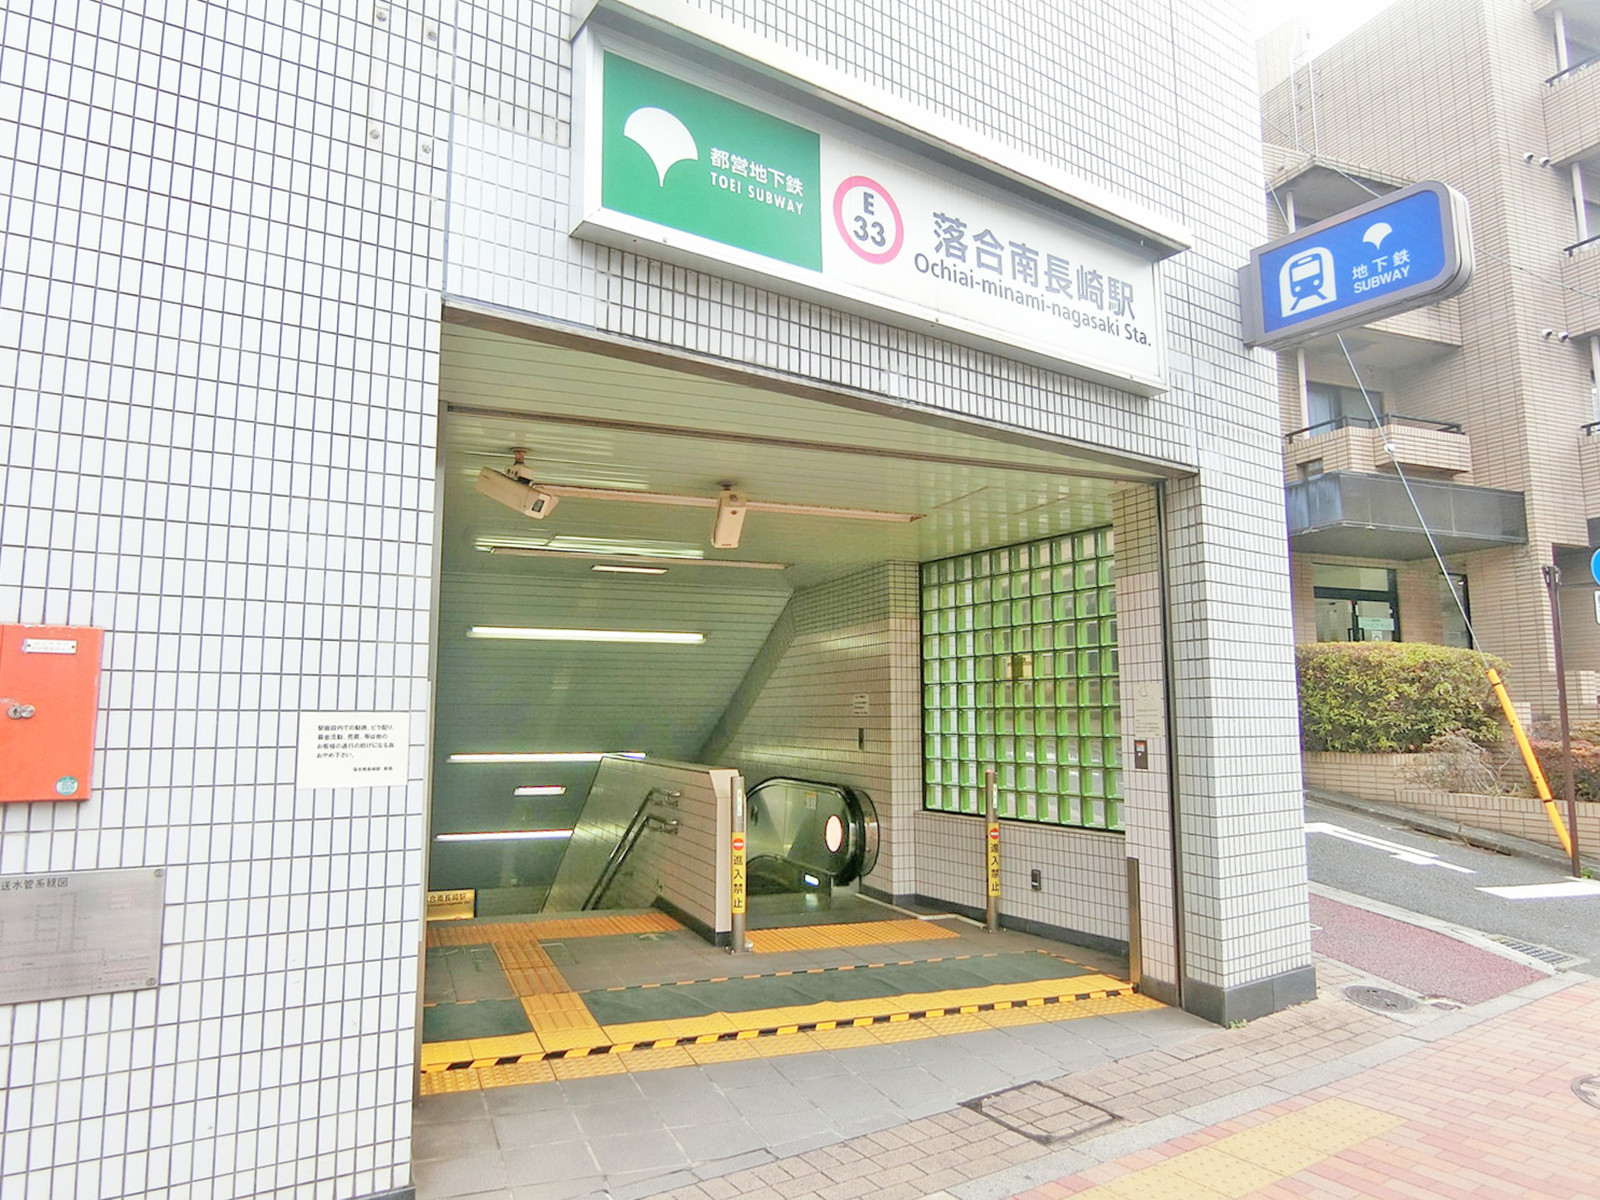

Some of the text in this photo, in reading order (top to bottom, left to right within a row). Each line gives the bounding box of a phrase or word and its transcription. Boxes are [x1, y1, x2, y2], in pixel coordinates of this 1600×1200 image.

[710, 147, 804, 198] 都営地下鉄
[710, 171, 804, 216] TOEI SUBWAY
[863, 191, 875, 216] E
[853, 215, 886, 248] 33
[933, 211, 1136, 321] 落合南長崎駅
[1352, 248, 1411, 280] 地下鉄
[1353, 264, 1411, 294] SUBWAY
[914, 252, 1152, 347] Ochiai-minami-nagasaki Sta.
[733, 854, 744, 909] 進入禁止
[990, 843, 1000, 892] 進入禁止
